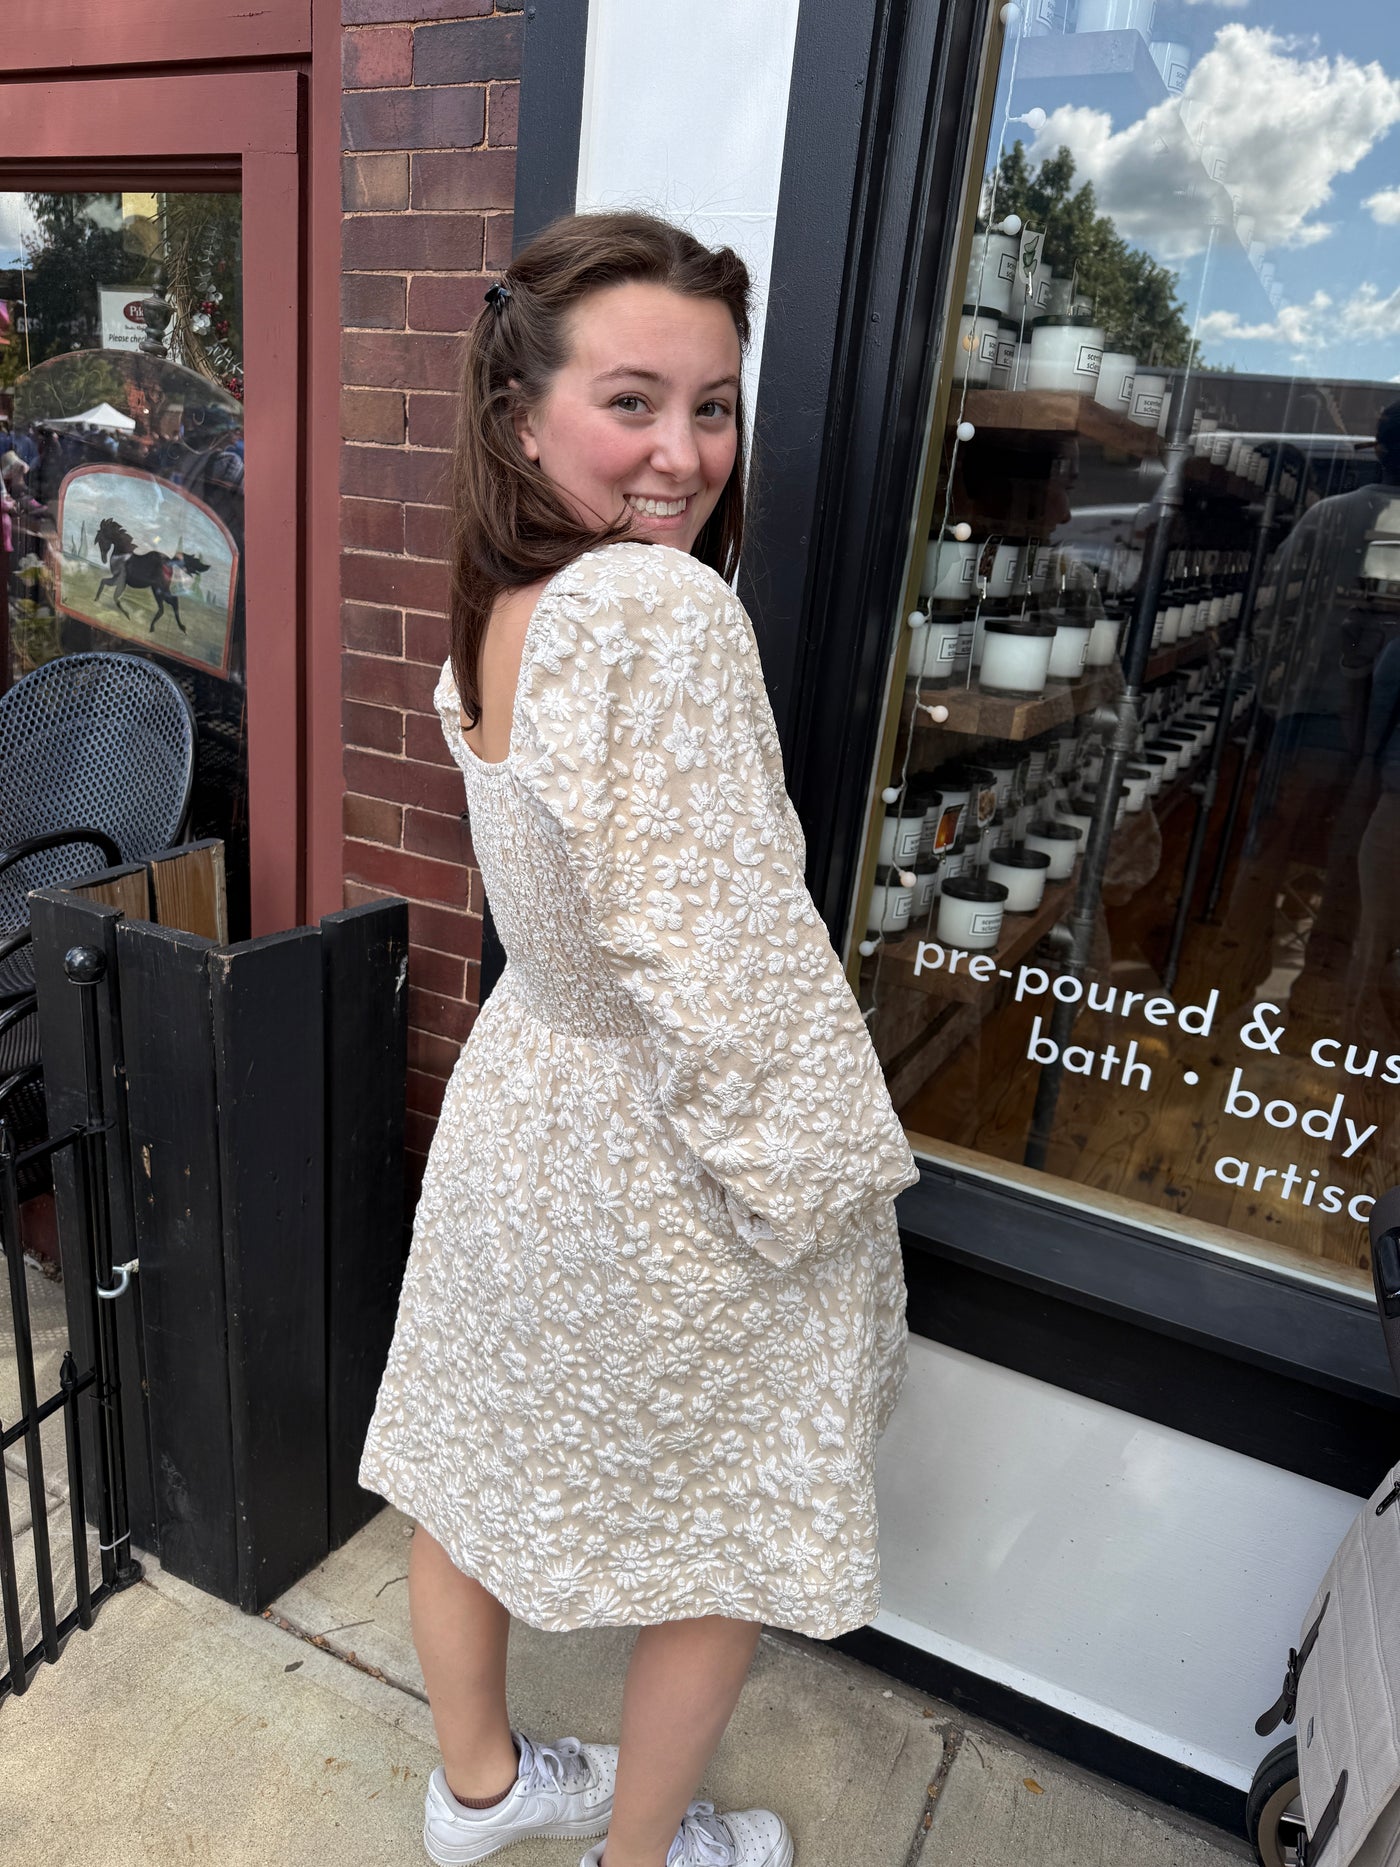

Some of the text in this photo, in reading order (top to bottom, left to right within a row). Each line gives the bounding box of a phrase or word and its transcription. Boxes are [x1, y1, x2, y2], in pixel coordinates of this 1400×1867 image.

[914, 941, 1220, 1037] pre-poured
[1240, 1002, 1286, 1055] &
[1027, 1016, 1378, 1158] bath body
